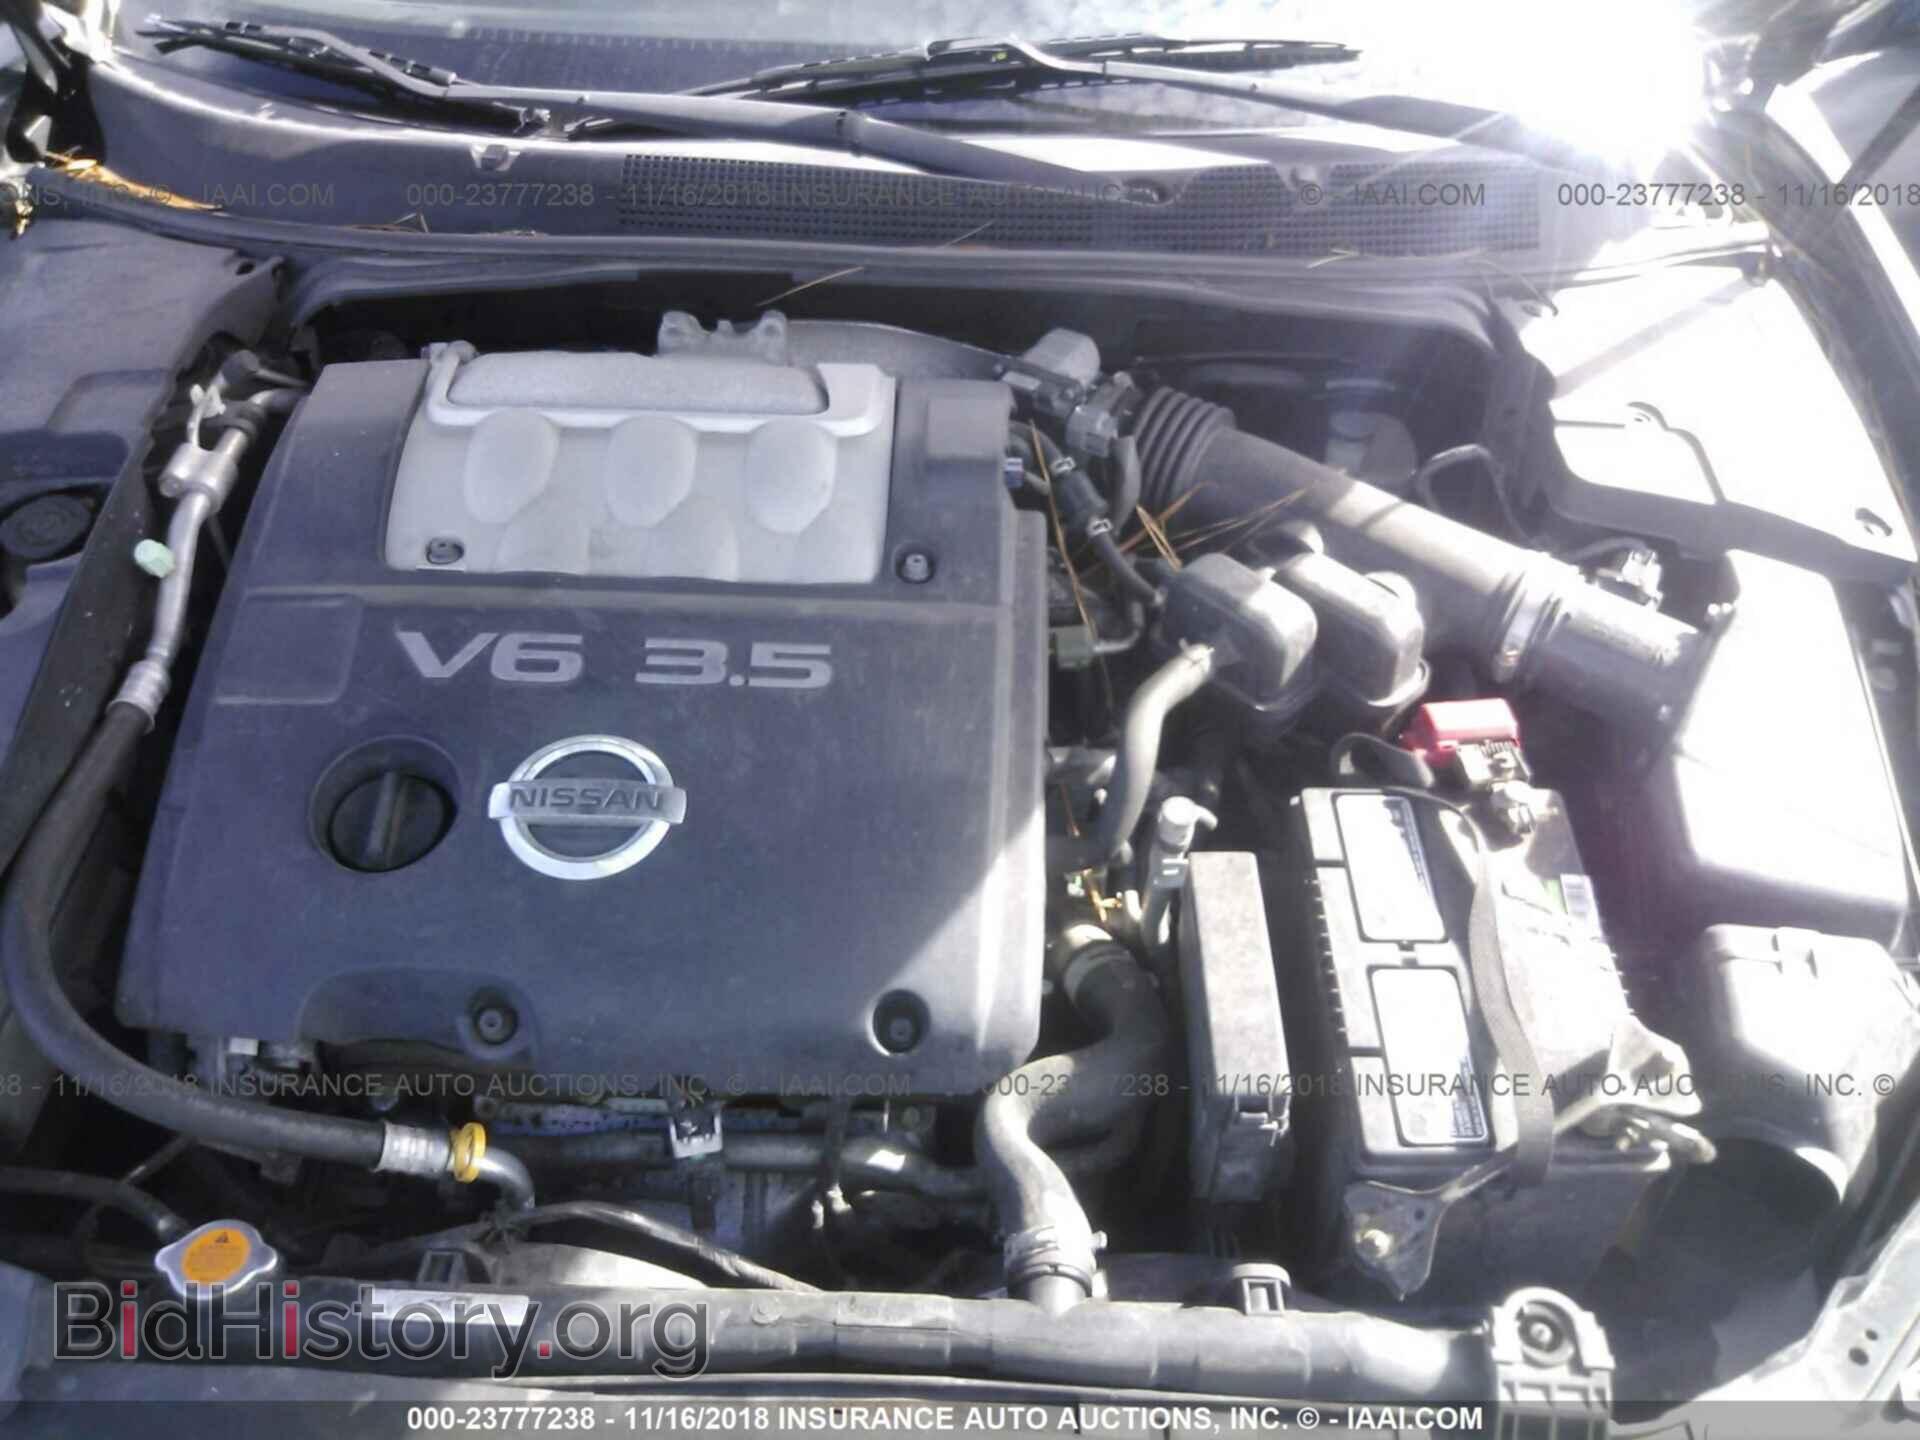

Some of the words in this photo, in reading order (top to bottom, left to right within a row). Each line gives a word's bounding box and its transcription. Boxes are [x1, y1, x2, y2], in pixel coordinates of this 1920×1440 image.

[394, 631, 584, 684] V6
[635, 638, 832, 688] 3.5
[509, 785, 665, 811] NISSAN
